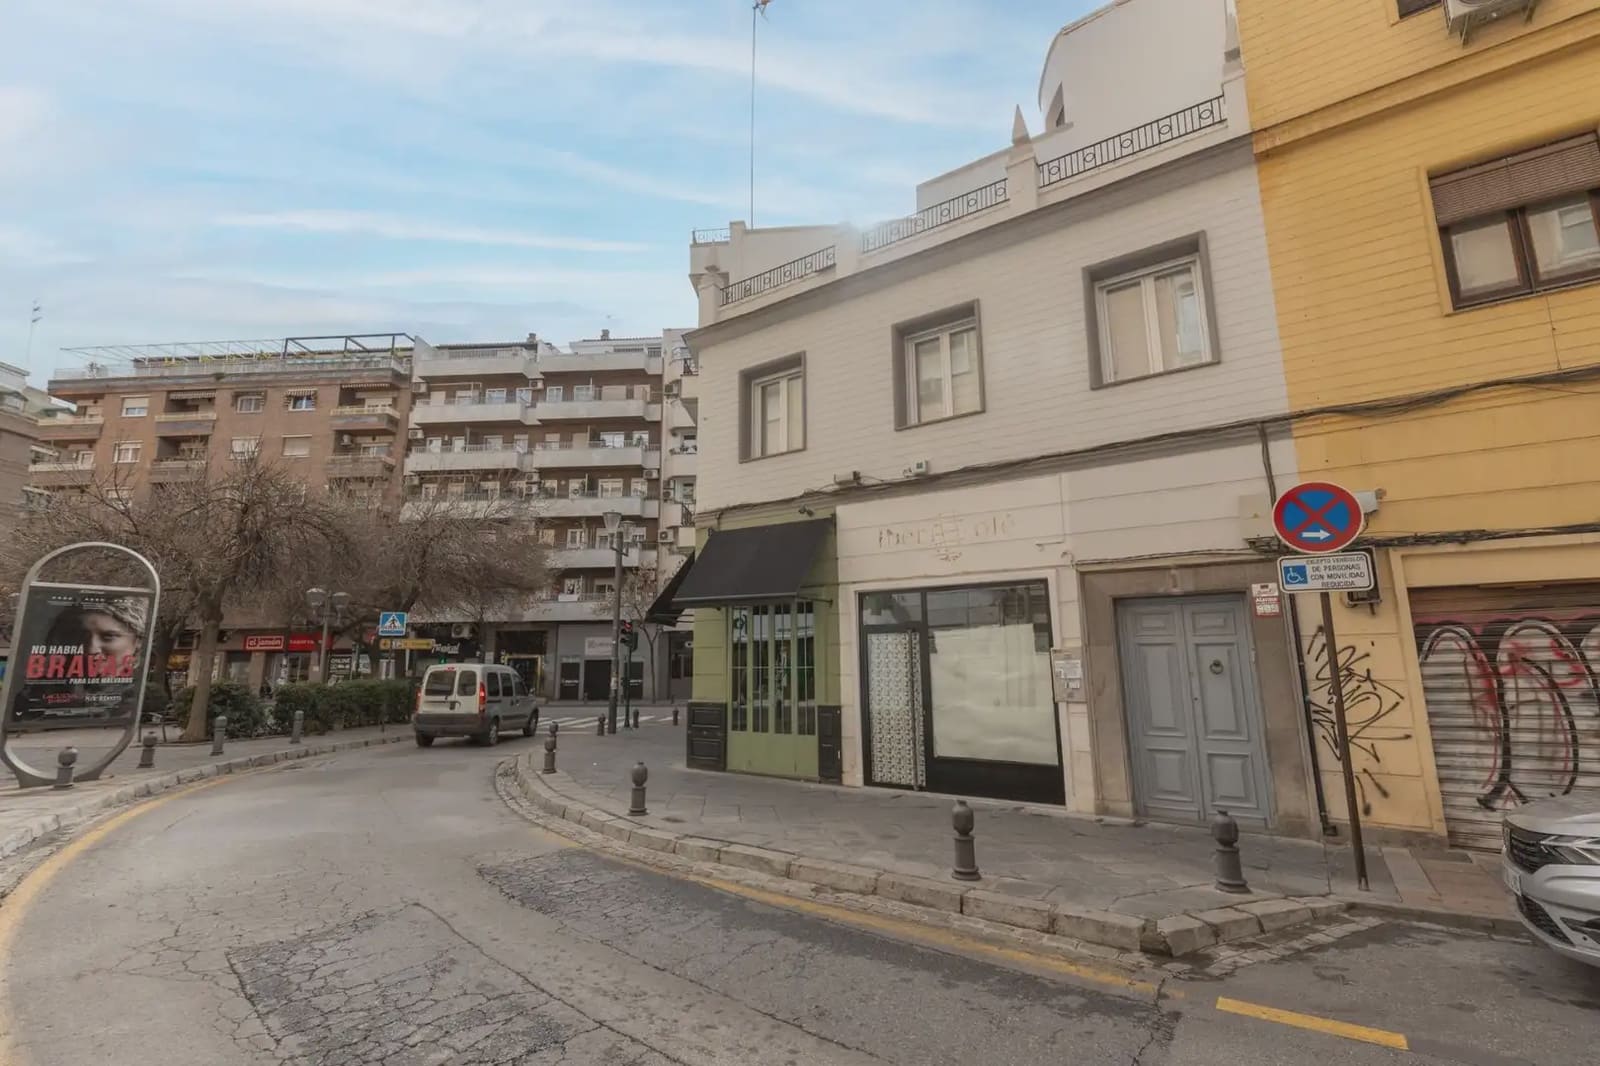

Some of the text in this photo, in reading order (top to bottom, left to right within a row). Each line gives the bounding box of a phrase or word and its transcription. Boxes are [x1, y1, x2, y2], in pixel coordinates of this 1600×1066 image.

[1323, 564, 1361, 572] PERSONAS
[1327, 571, 1366, 579] MOVILIDAD
[1321, 580, 1356, 588] REDUCIDA
[32, 644, 84, 655] NO HABRÁ
[27, 654, 136, 678] BRAVAS
